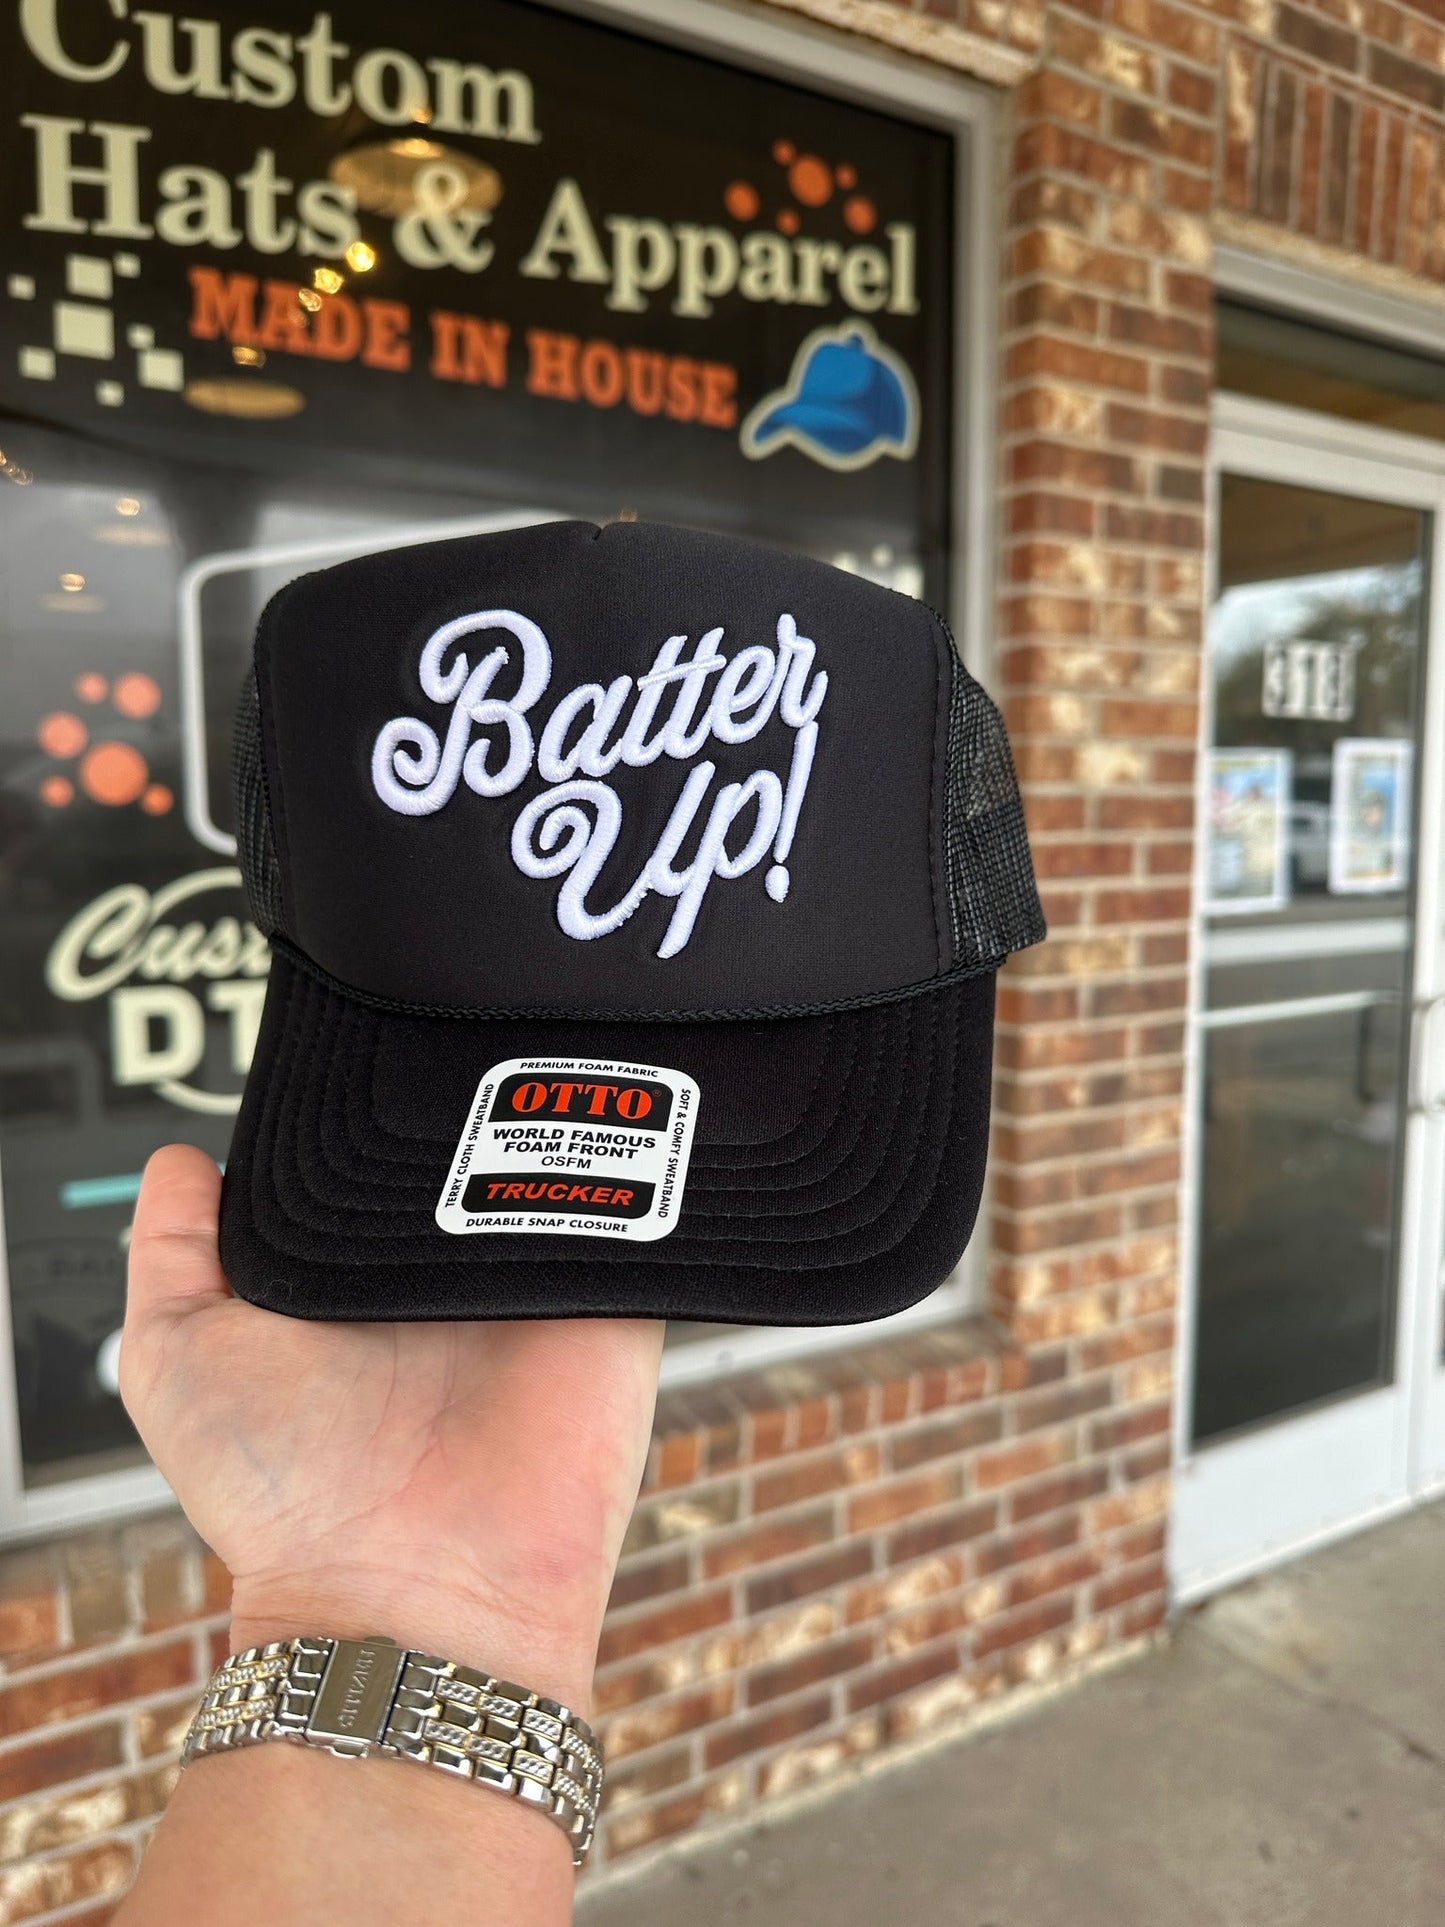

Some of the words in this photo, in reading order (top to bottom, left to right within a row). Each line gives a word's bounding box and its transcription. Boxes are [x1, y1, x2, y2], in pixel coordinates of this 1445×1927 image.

[19, 0, 542, 145] Custom
[20, 112, 361, 260] Hats
[392, 162, 495, 273] &
[518, 177, 919, 318] Apparel
[188, 265, 411, 374] MADE
[430, 309, 510, 390] IN
[525, 327, 738, 429] HOUSE
[371, 609, 828, 816] Batter
[510, 721, 819, 959] Up!
[520, 1061, 574, 1070] PREMIUM
[578, 1062, 613, 1072] FOAM
[617, 1065, 659, 1078] FABRIC
[678, 1088, 691, 1110] SOFT
[676, 1111, 687, 1119] &
[444, 1178, 463, 1208] TERRY
[456, 1143, 475, 1175] CLOTH
[467, 1083, 494, 1141] SWEATBAND
[493, 1128, 565, 1140] WORLD
[571, 1130, 657, 1149] FAMOUS
[503, 1141, 562, 1153] FOAM
[567, 1142, 639, 1159] FRONT
[670, 1121, 685, 1155] COMFY
[541, 1155, 592, 1169] OSFM
[486, 1182, 635, 1206] TRUCKER
[657, 1157, 679, 1218] SWEATBAND
[465, 1218, 525, 1228] DURABLE
[528, 1218, 566, 1227] SNAP
[569, 1219, 629, 1233] CLOSURE
